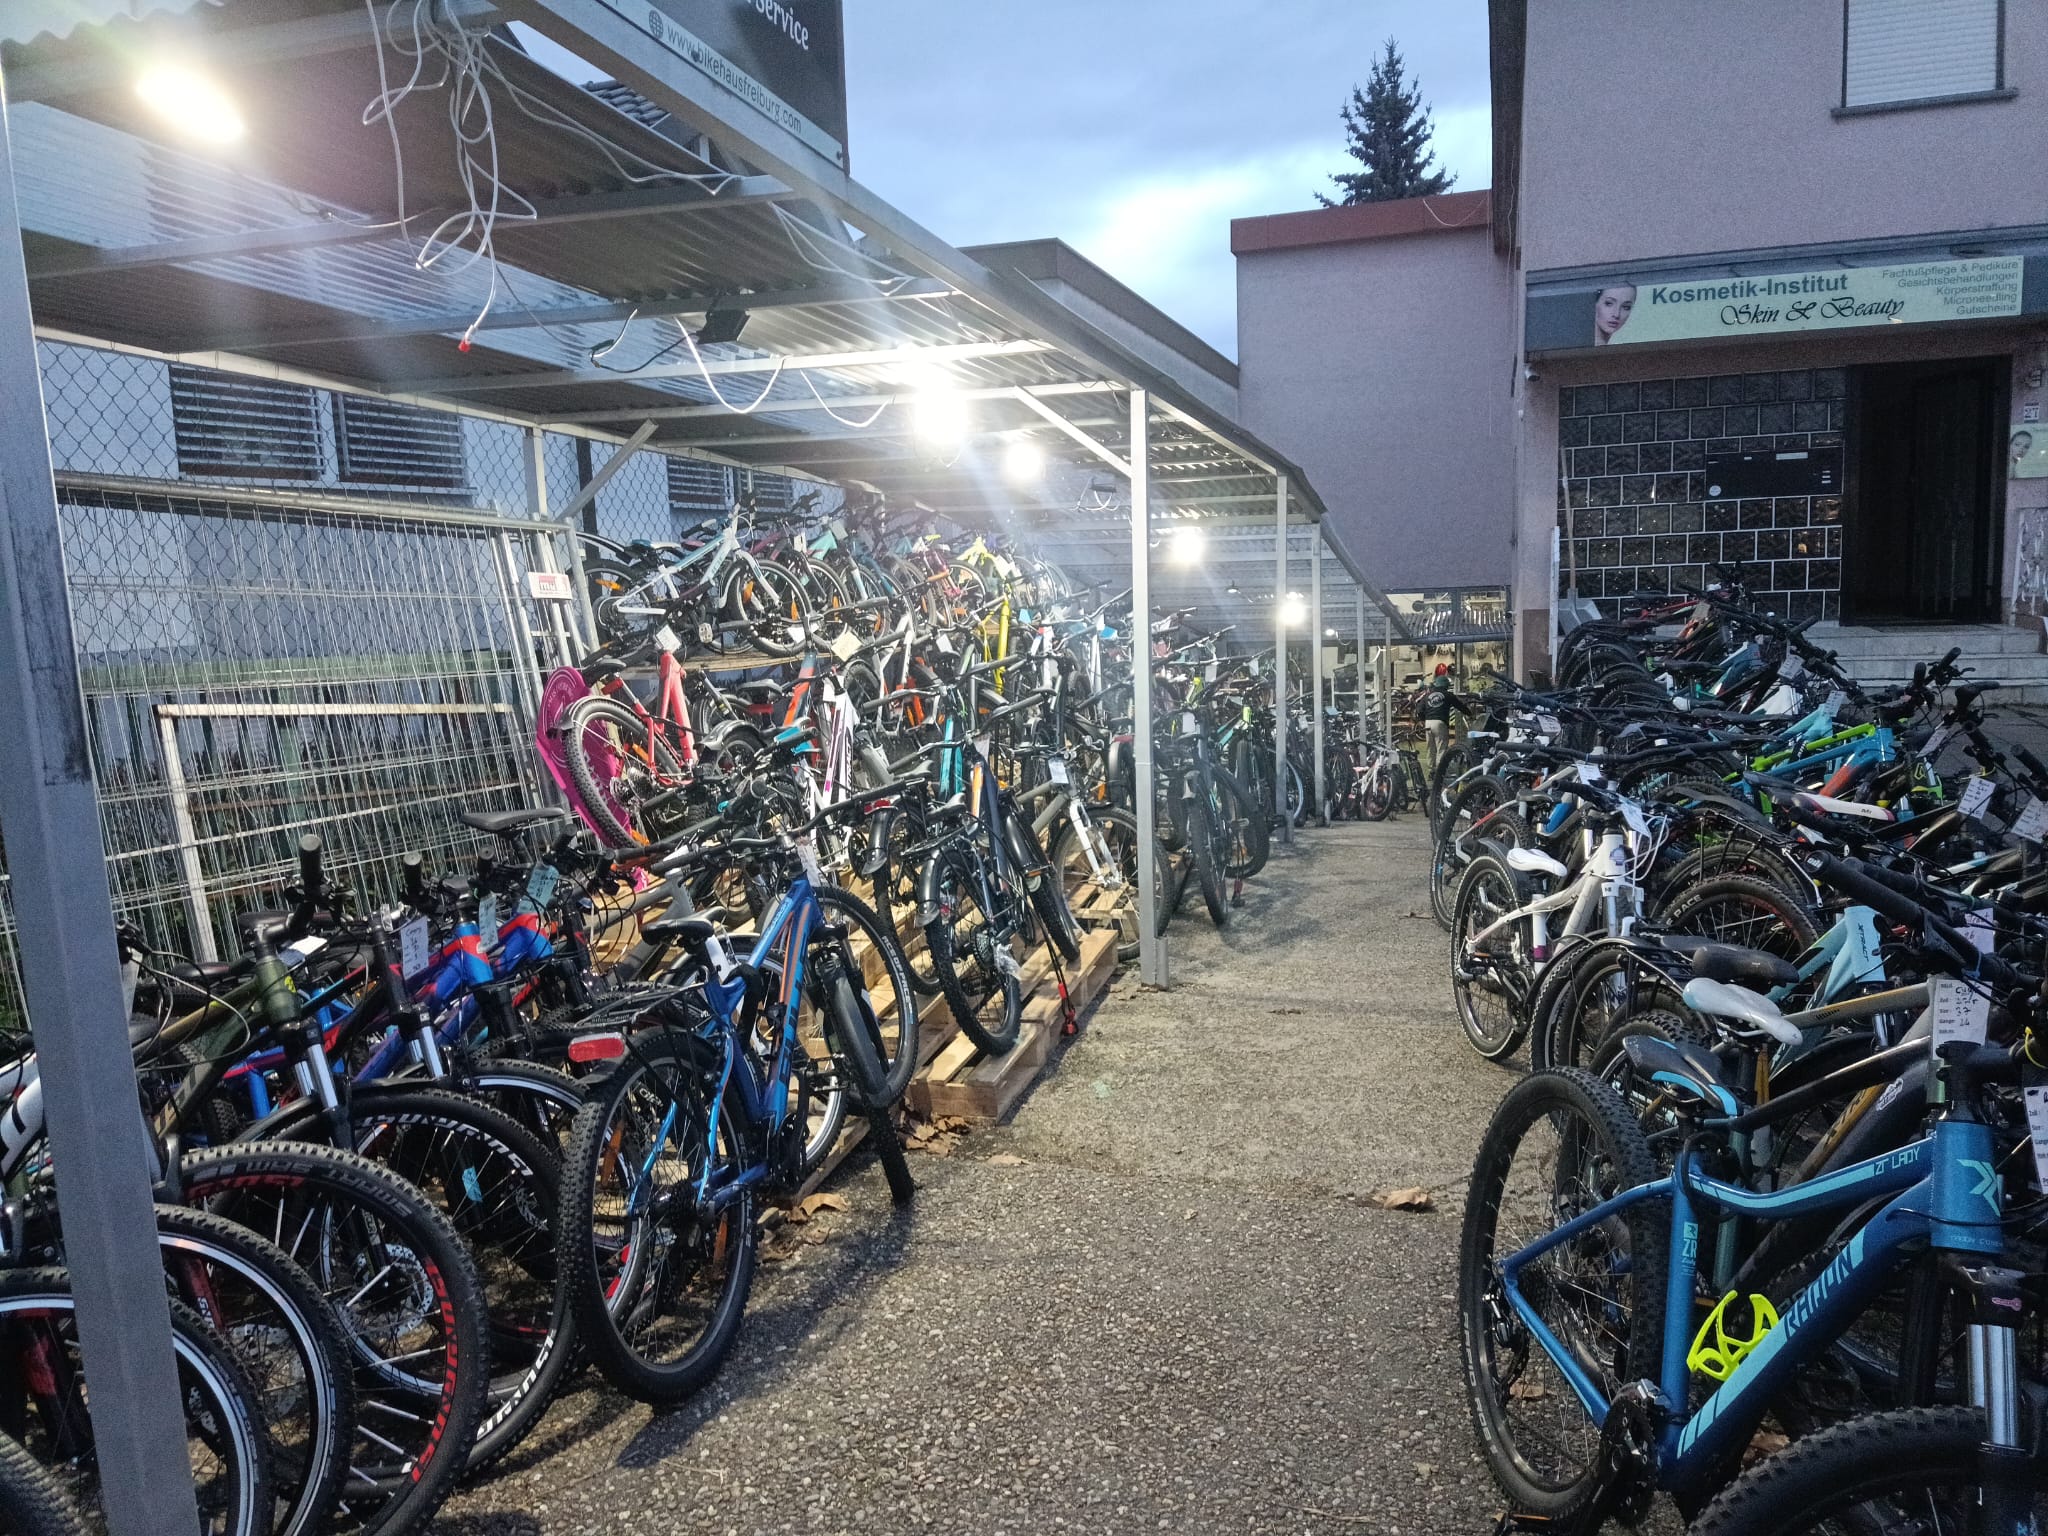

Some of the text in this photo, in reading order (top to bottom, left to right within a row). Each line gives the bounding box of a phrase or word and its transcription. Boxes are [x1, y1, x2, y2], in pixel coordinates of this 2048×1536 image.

[667, 25, 802, 134] www.bikehausfreiburg.com
[1652, 273, 1849, 305] Kosmetik-Institut
[1897, 272, 2018, 288] Gesichtsbehandlungen
[1720, 296, 1905, 326] Skin & Beauty
[1956, 303, 2017, 316] Gutscheine
[2024, 407, 2039, 419] 27
[1673, 894, 1703, 918] PACE
[1892, 1146, 1921, 1169] LADY
[1681, 1238, 1698, 1258] ZR
